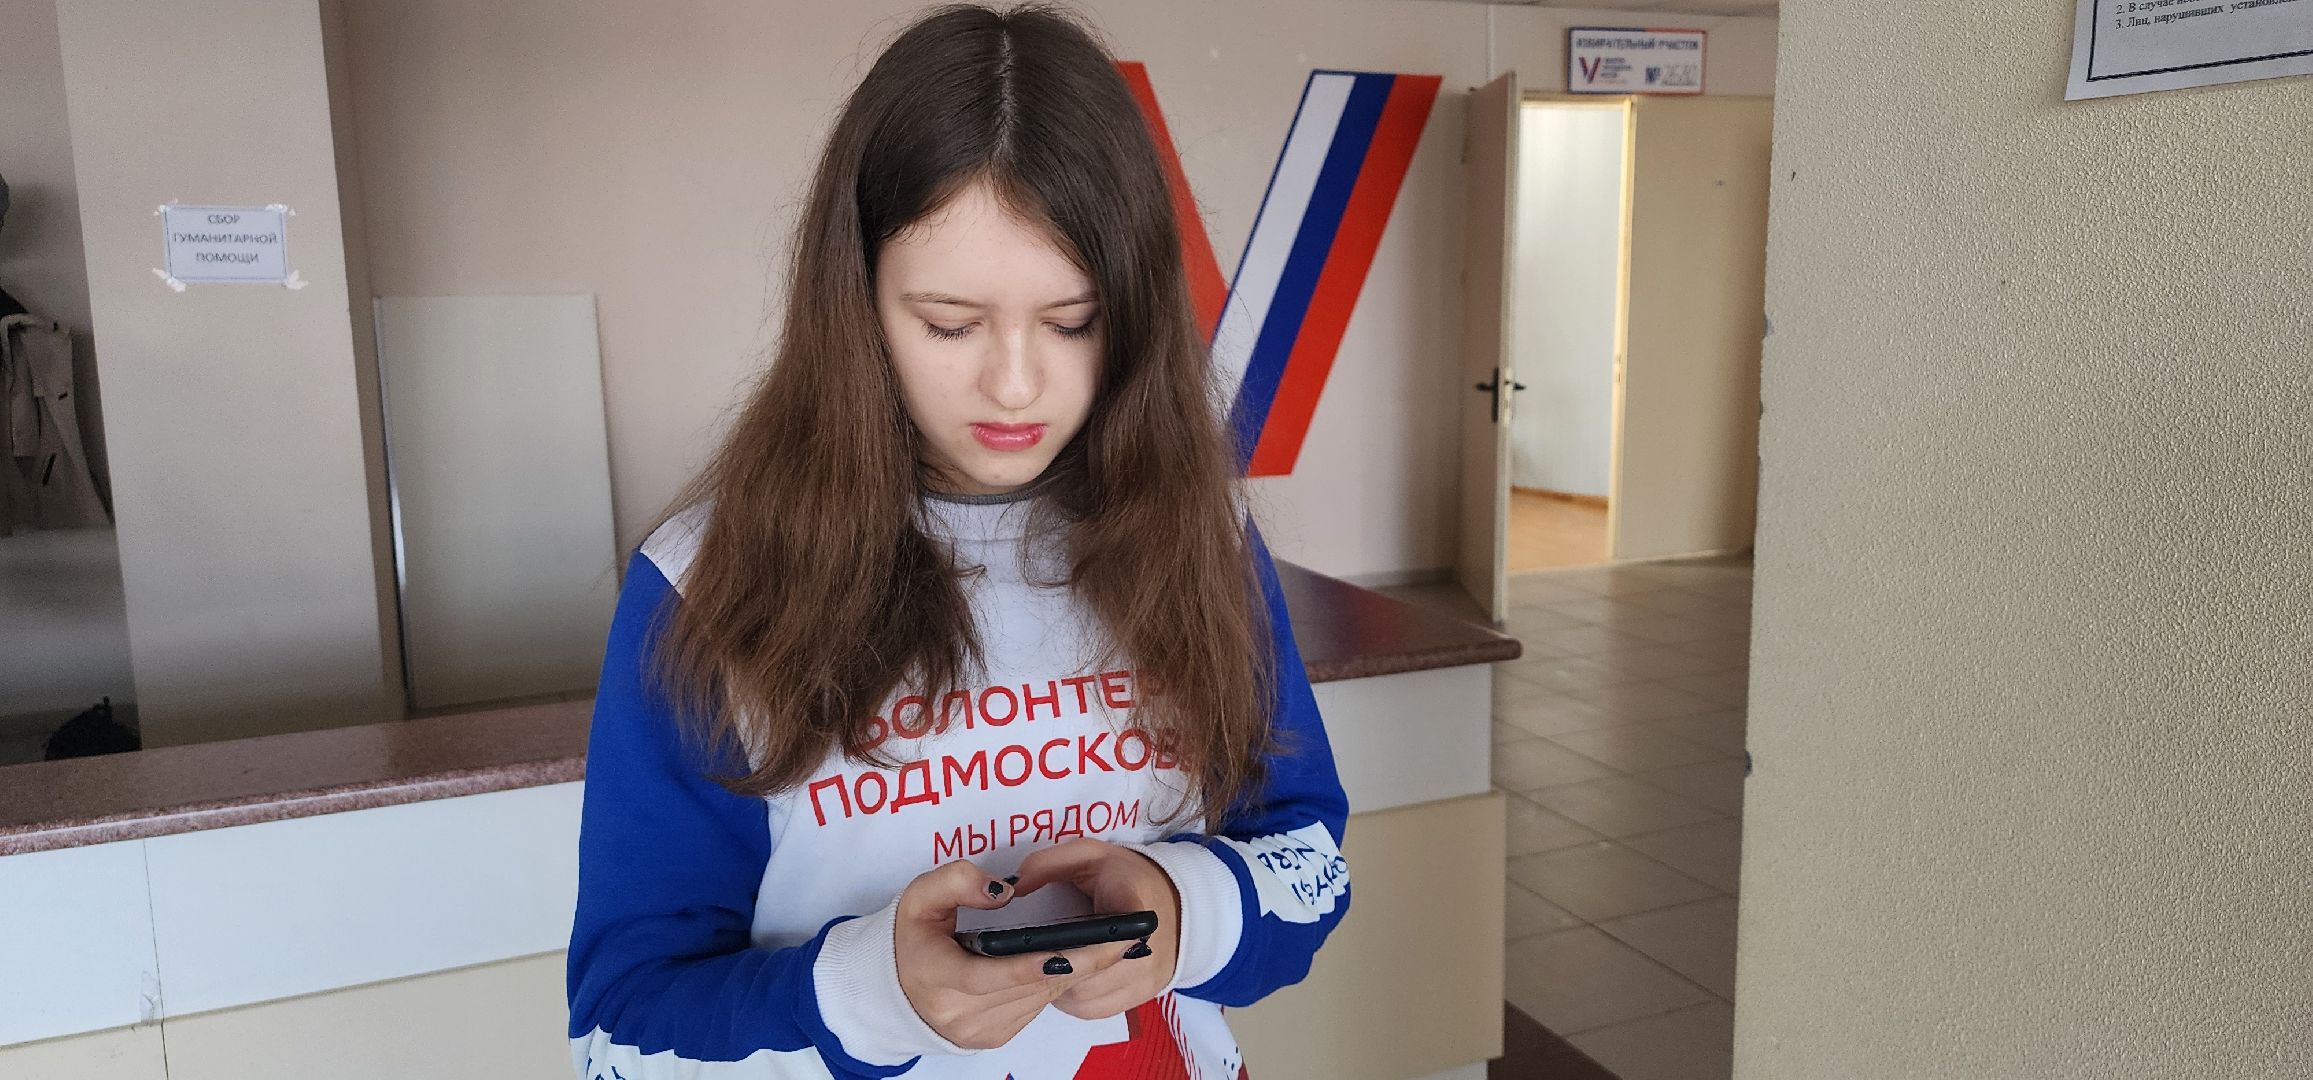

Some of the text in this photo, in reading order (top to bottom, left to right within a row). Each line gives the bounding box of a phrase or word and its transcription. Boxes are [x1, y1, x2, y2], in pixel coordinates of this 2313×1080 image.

[2128, 2, 2137, 13] В
[207, 214, 241, 225] СБОР
[173, 231, 278, 245] ГУМАНИТАРНОЙ
[195, 251, 260, 265] ПОМОЩИ
[931, 799, 1141, 865] МЫ РЯДОМ
